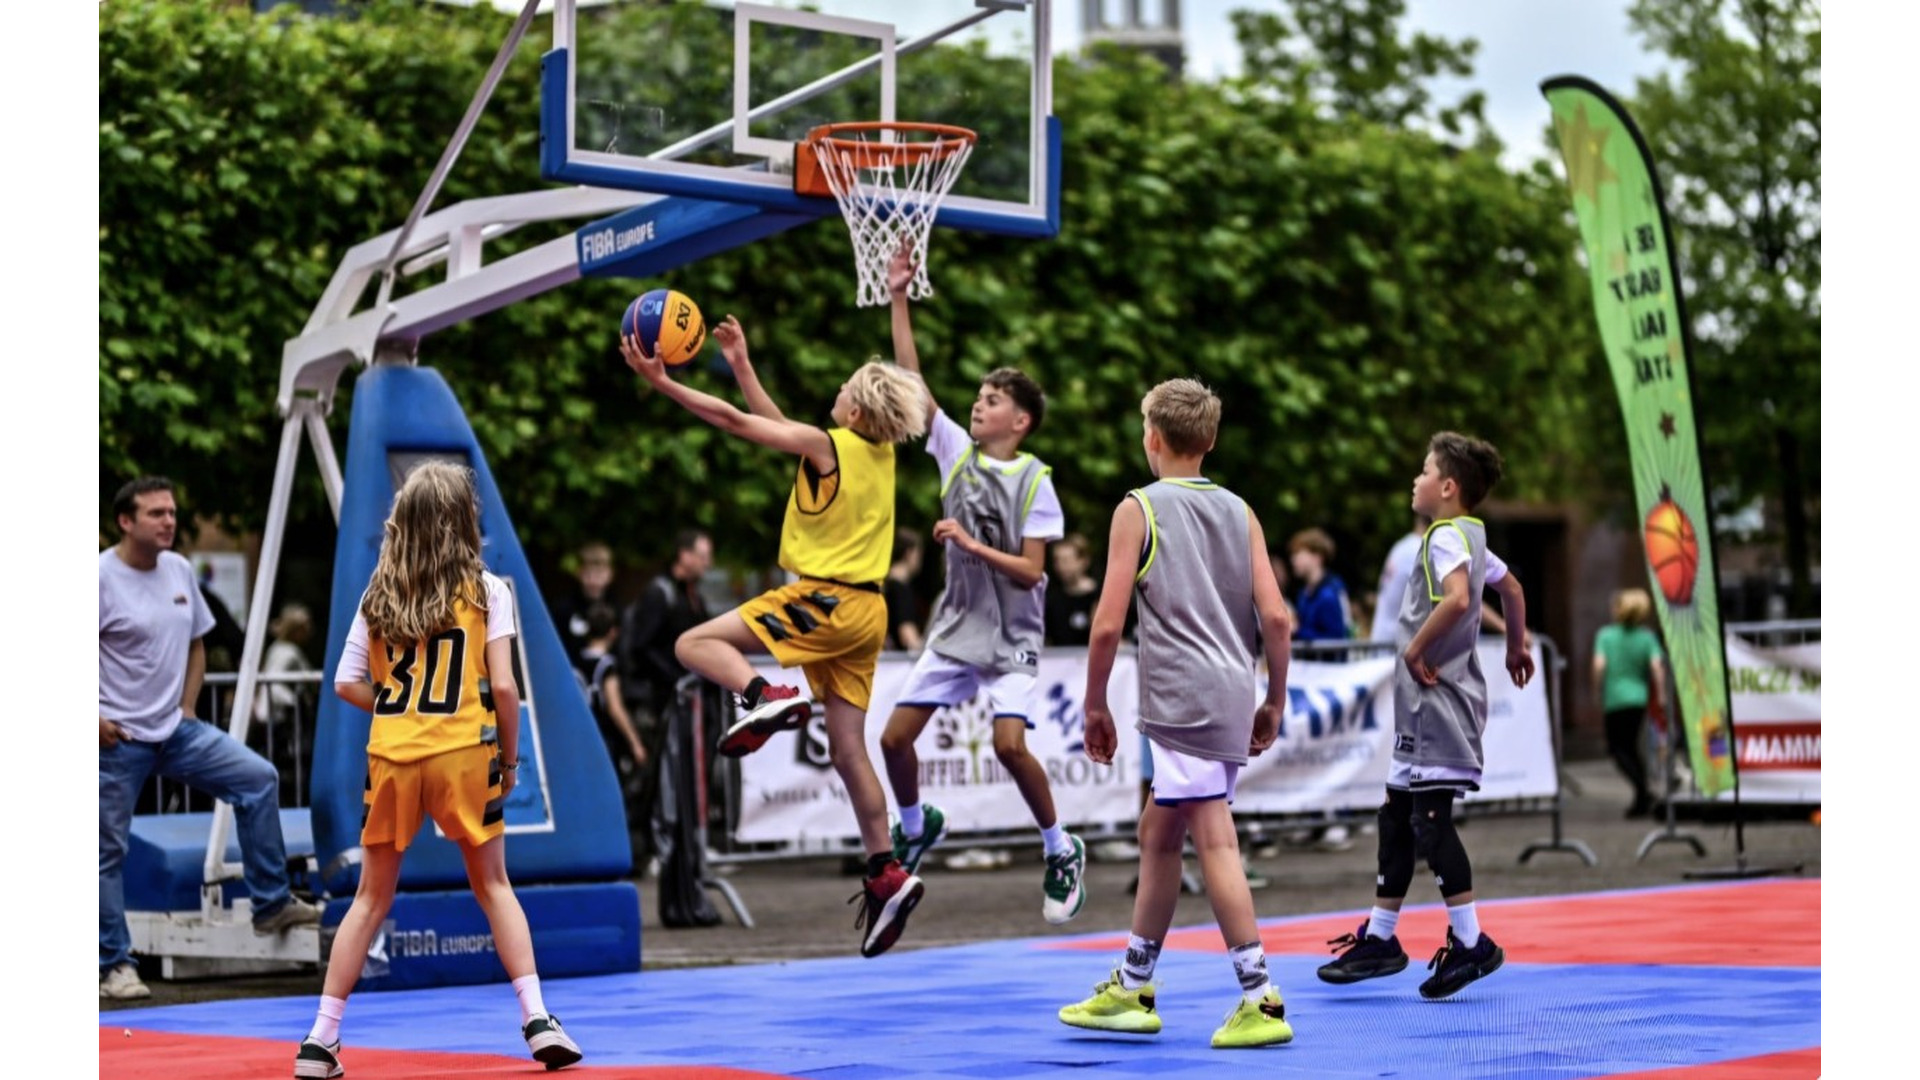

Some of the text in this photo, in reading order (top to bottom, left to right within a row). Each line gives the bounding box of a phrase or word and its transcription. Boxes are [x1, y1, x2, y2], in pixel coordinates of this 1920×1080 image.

[582, 221, 656, 263] FIBA EUROPE
[374, 627, 467, 717] 30
[390, 929, 438, 958] FIBA
